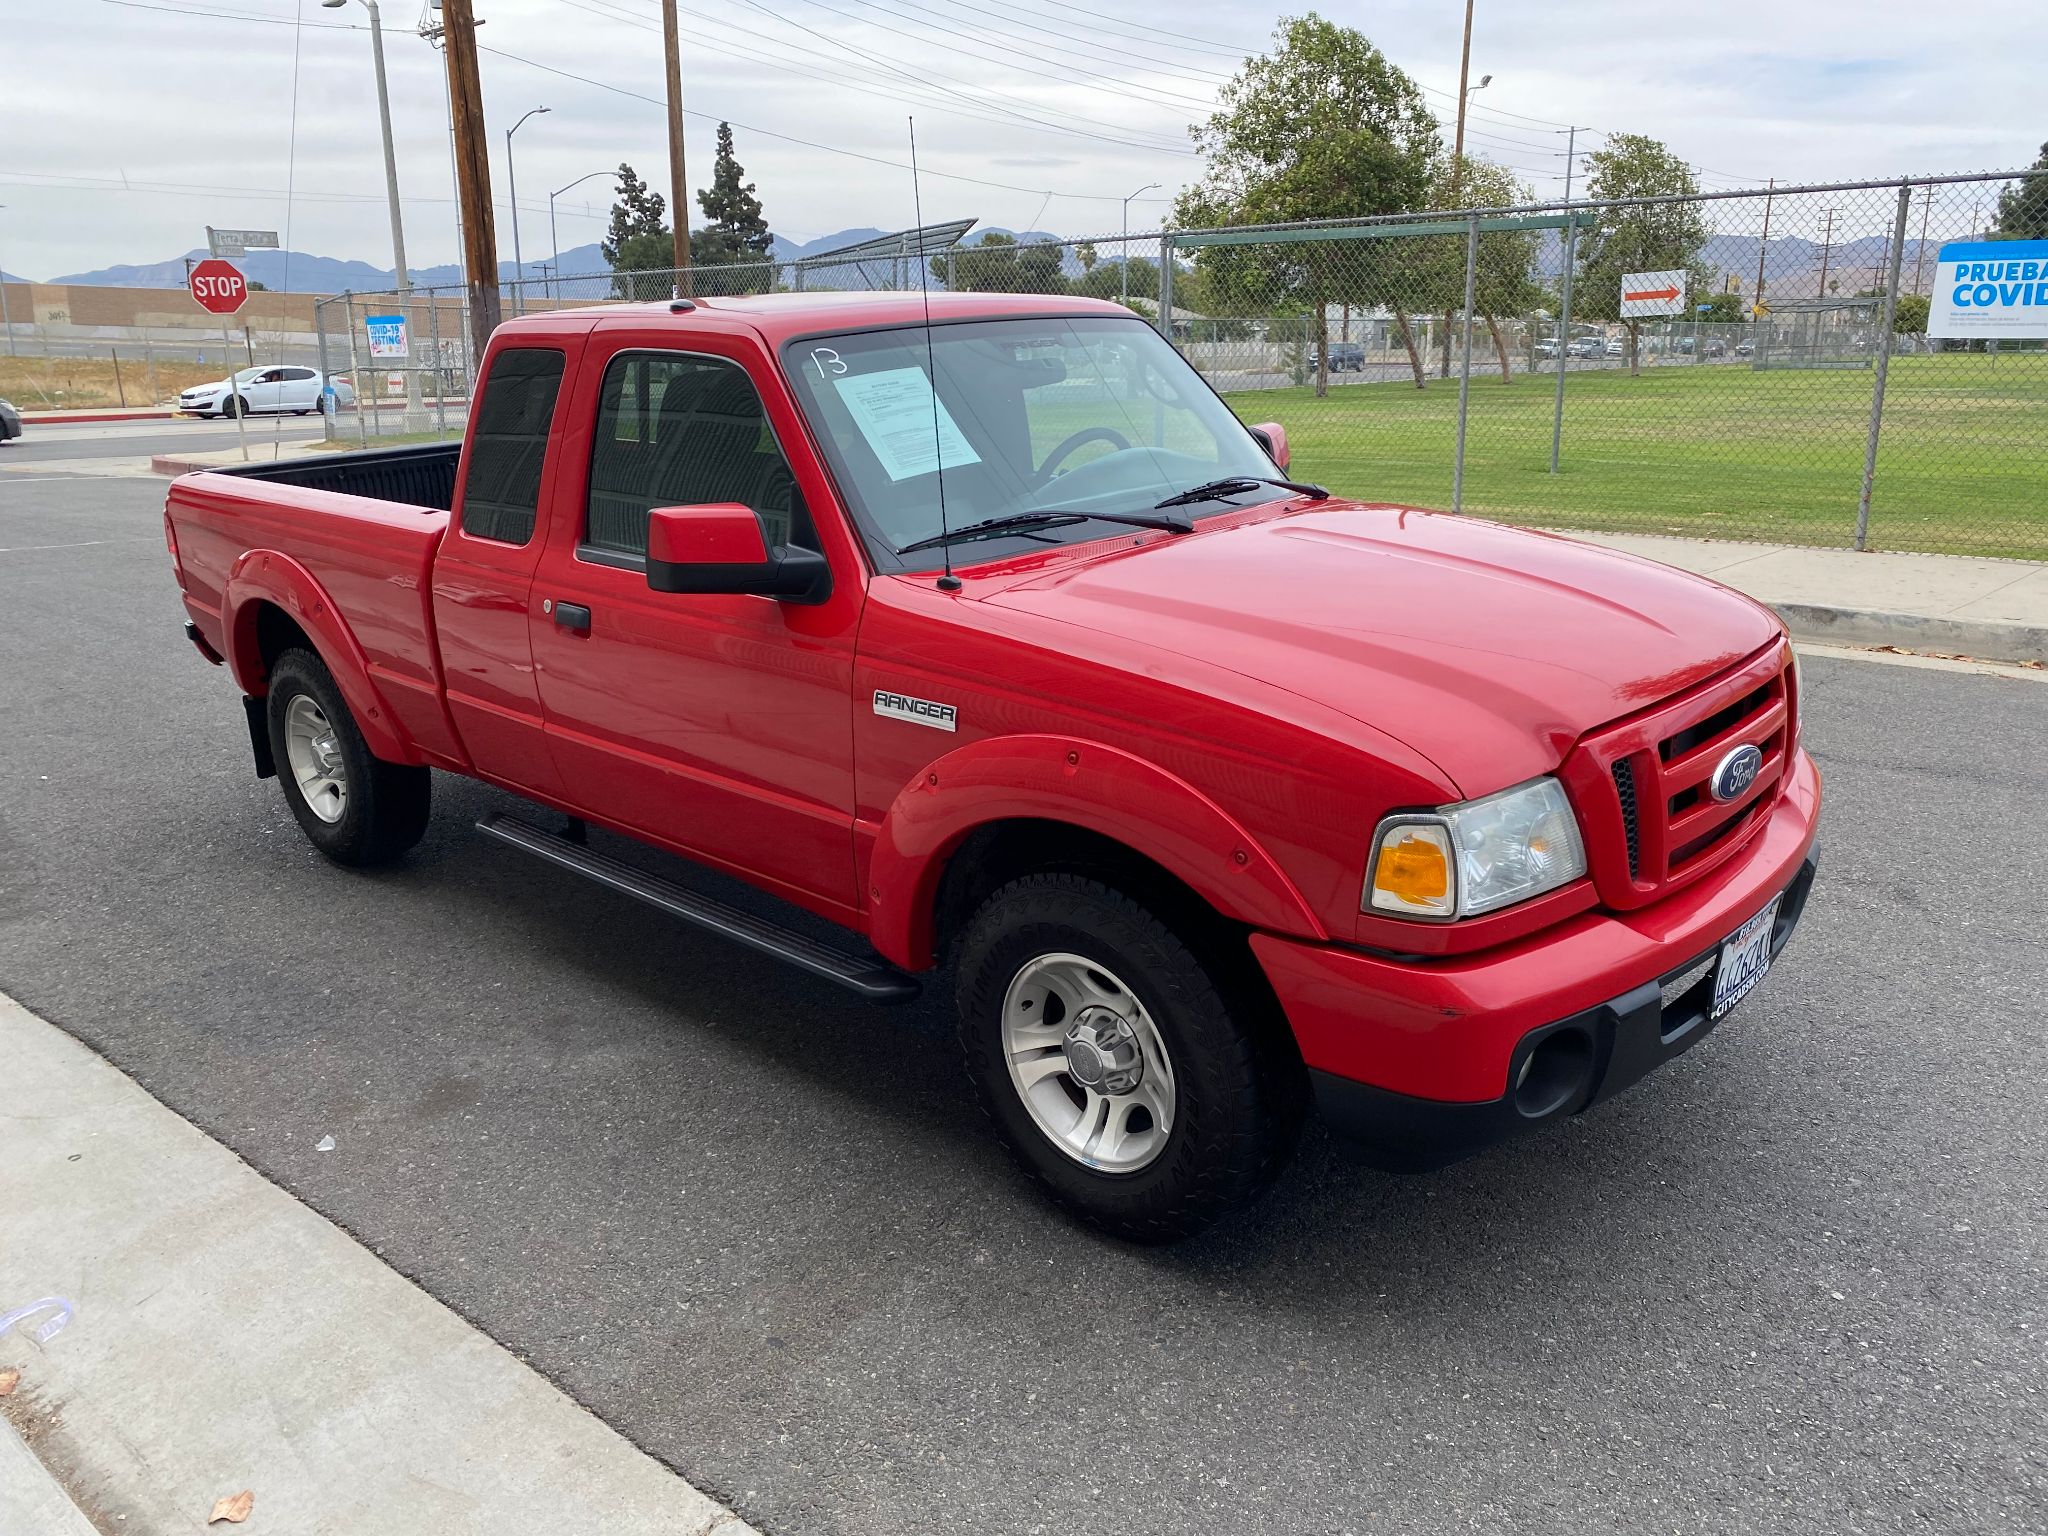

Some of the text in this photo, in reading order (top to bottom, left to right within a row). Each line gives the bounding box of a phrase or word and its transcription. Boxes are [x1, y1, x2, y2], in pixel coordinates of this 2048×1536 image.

[216, 232, 239, 243] Terra
[194, 276, 242, 297] STOP
[369, 325, 400, 336] COVID-19
[370, 335, 400, 346] TESTING
[874, 691, 956, 722] RANGER
[1729, 756, 1757, 793] Ford
